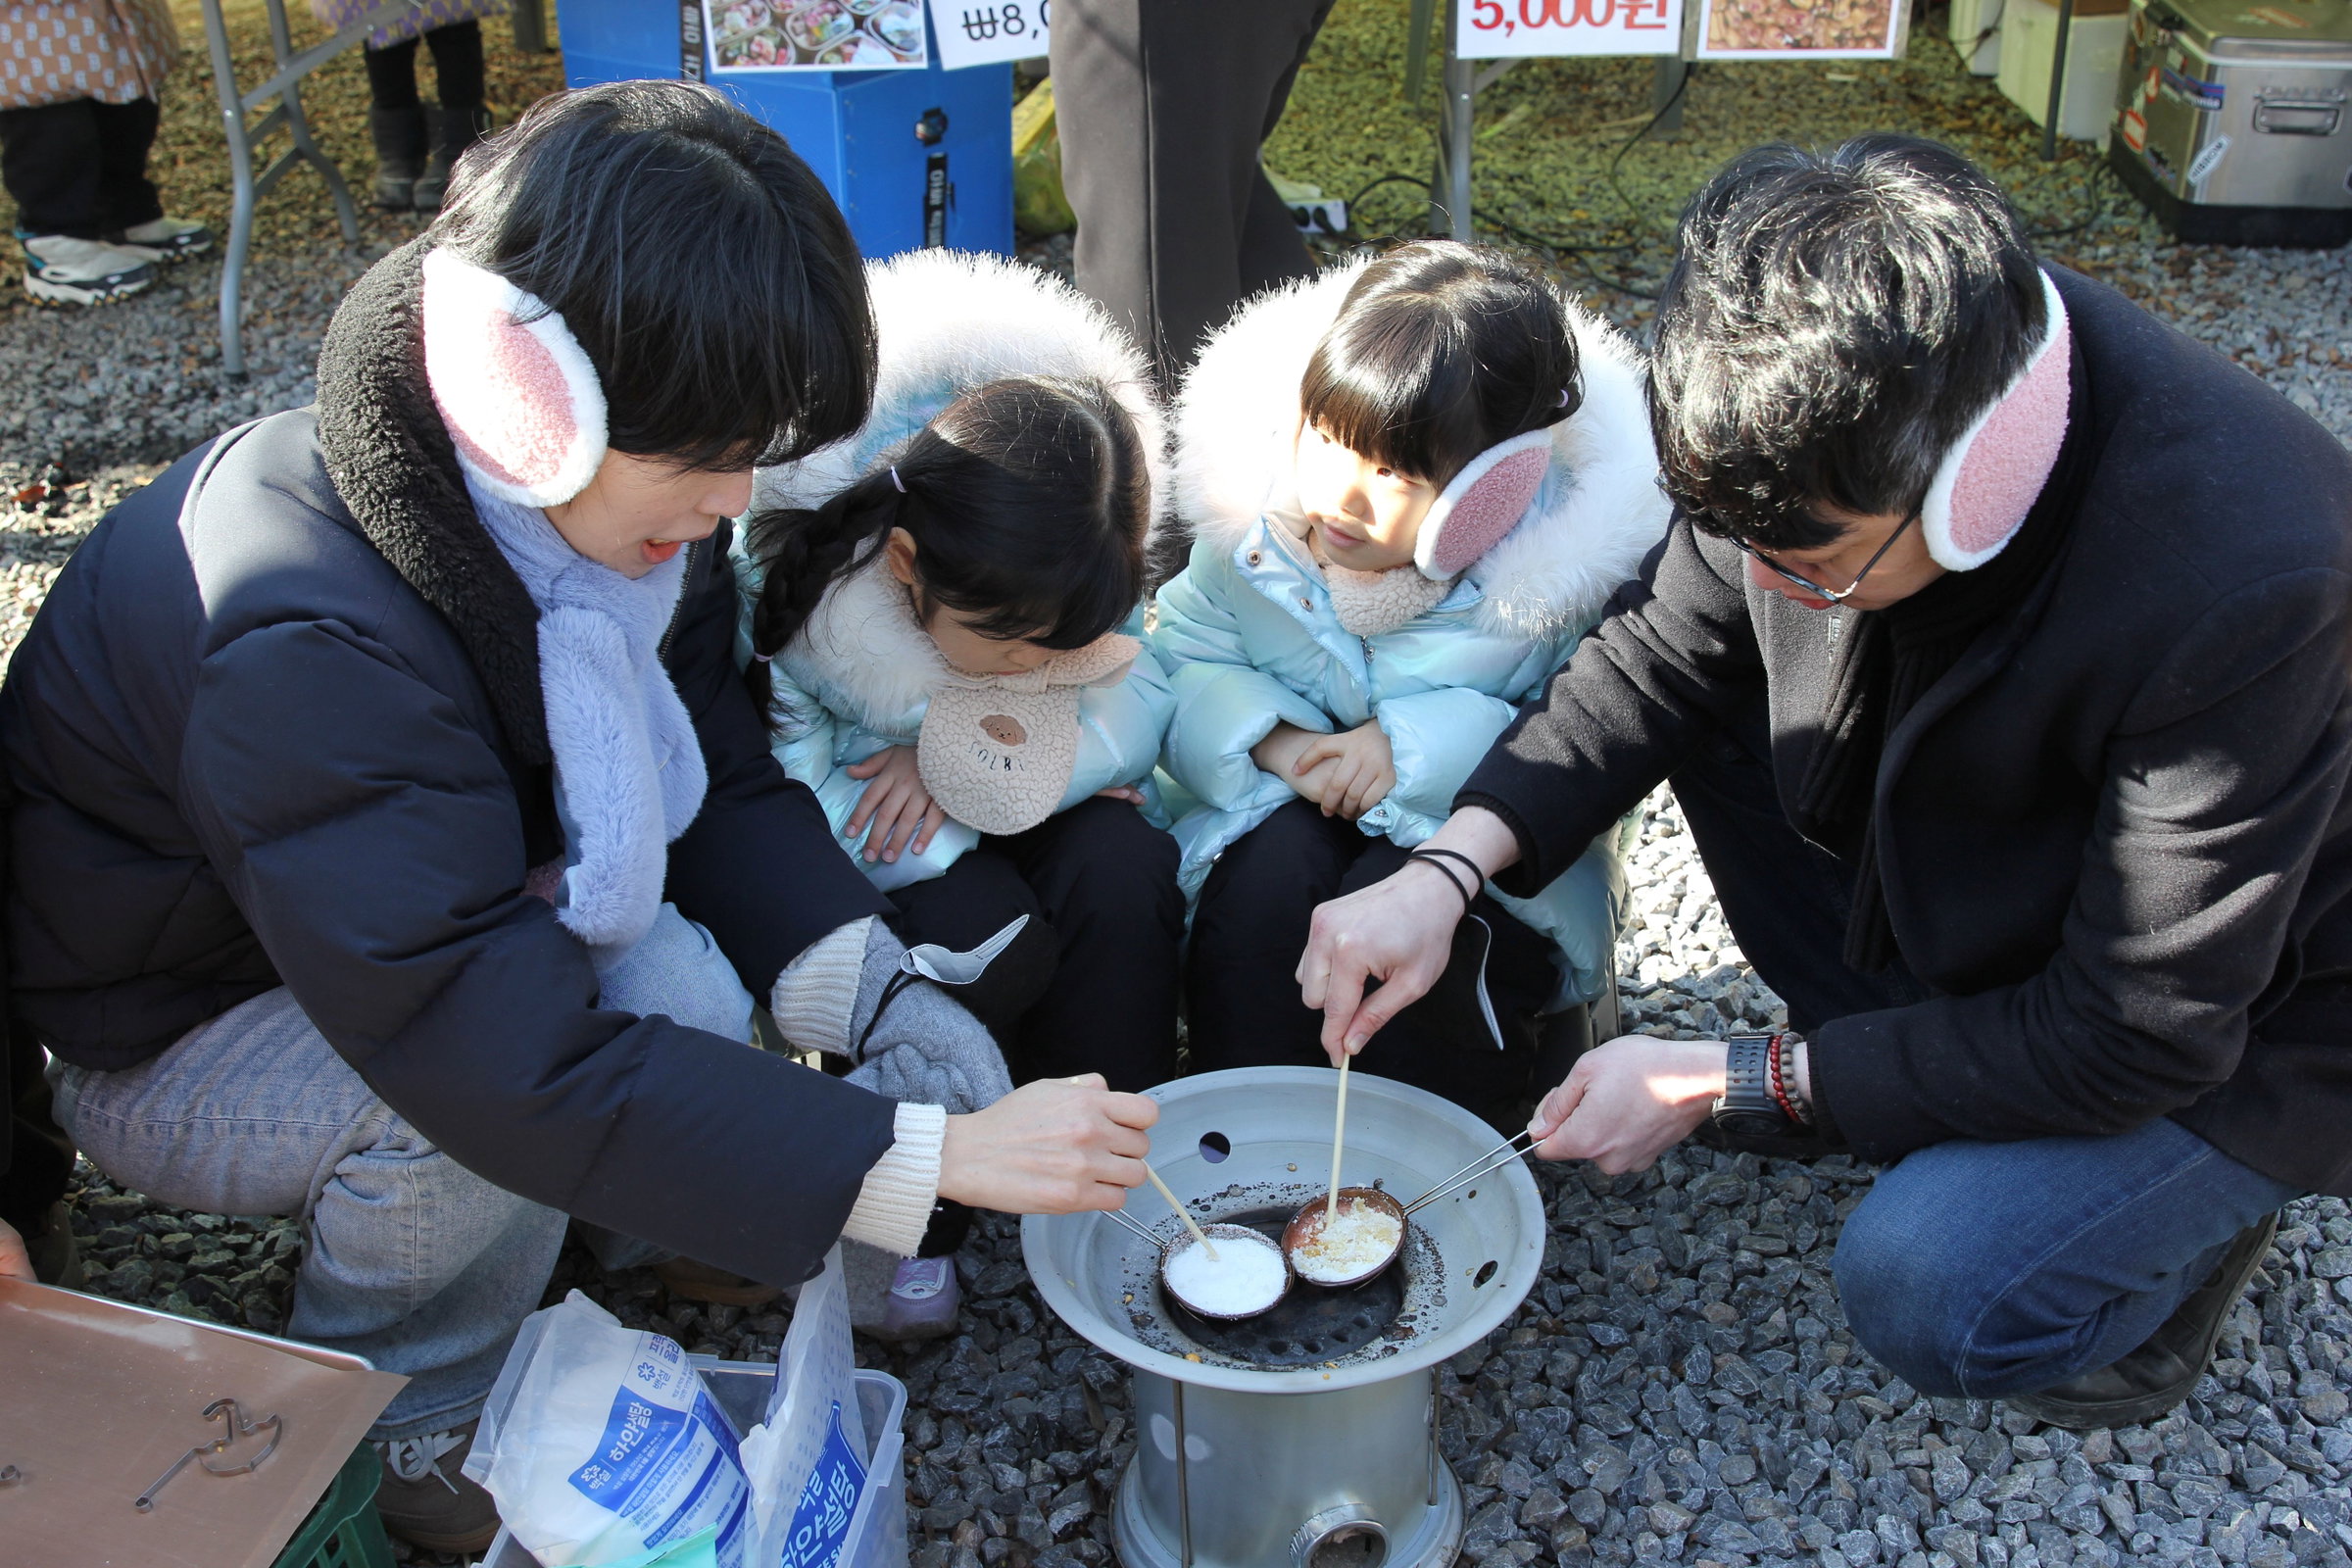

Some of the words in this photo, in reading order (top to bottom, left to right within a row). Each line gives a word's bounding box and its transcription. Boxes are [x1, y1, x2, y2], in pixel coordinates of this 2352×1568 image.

[653, 1369, 671, 1390] 백설
[609, 1401, 653, 1461] 하얀설탕
[589, 1469, 612, 1490] 백설
